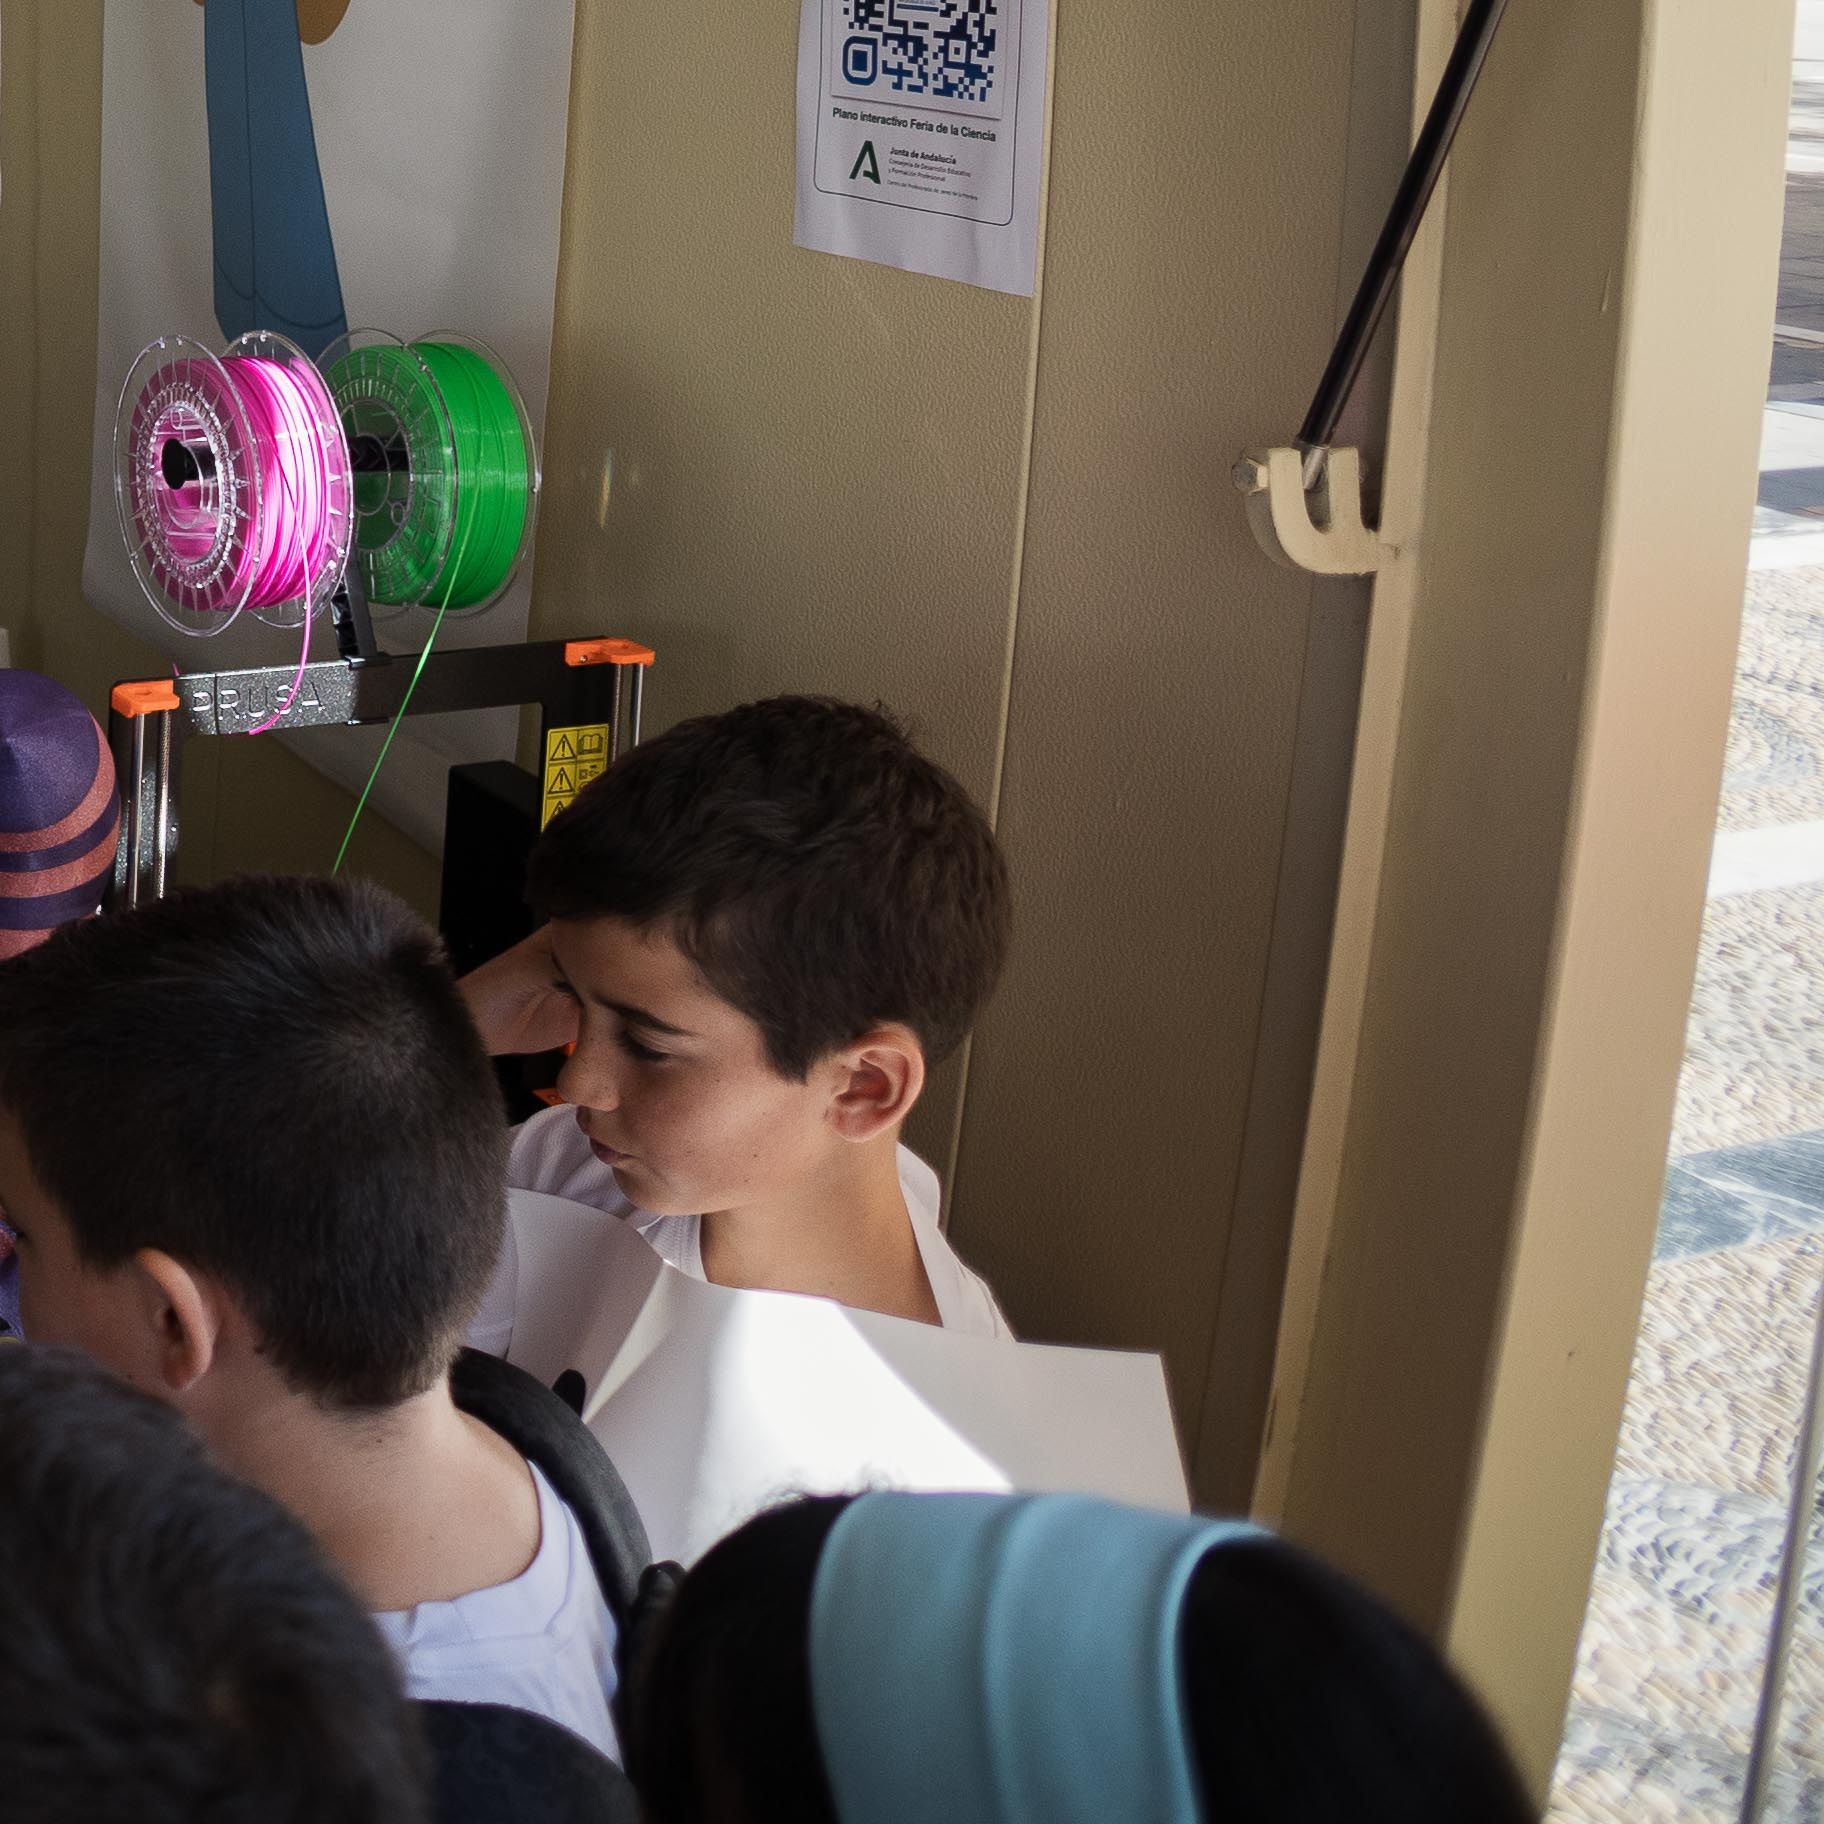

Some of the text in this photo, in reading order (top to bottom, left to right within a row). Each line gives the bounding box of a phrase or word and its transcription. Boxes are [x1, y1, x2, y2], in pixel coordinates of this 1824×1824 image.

[832, 106, 859, 121] Plano
[909, 118, 934, 132] Feria
[936, 122, 949, 134] de
[950, 124, 959, 136] la
[960, 126, 997, 143] Ciencia
[191, 680, 326, 721] PRUSA
